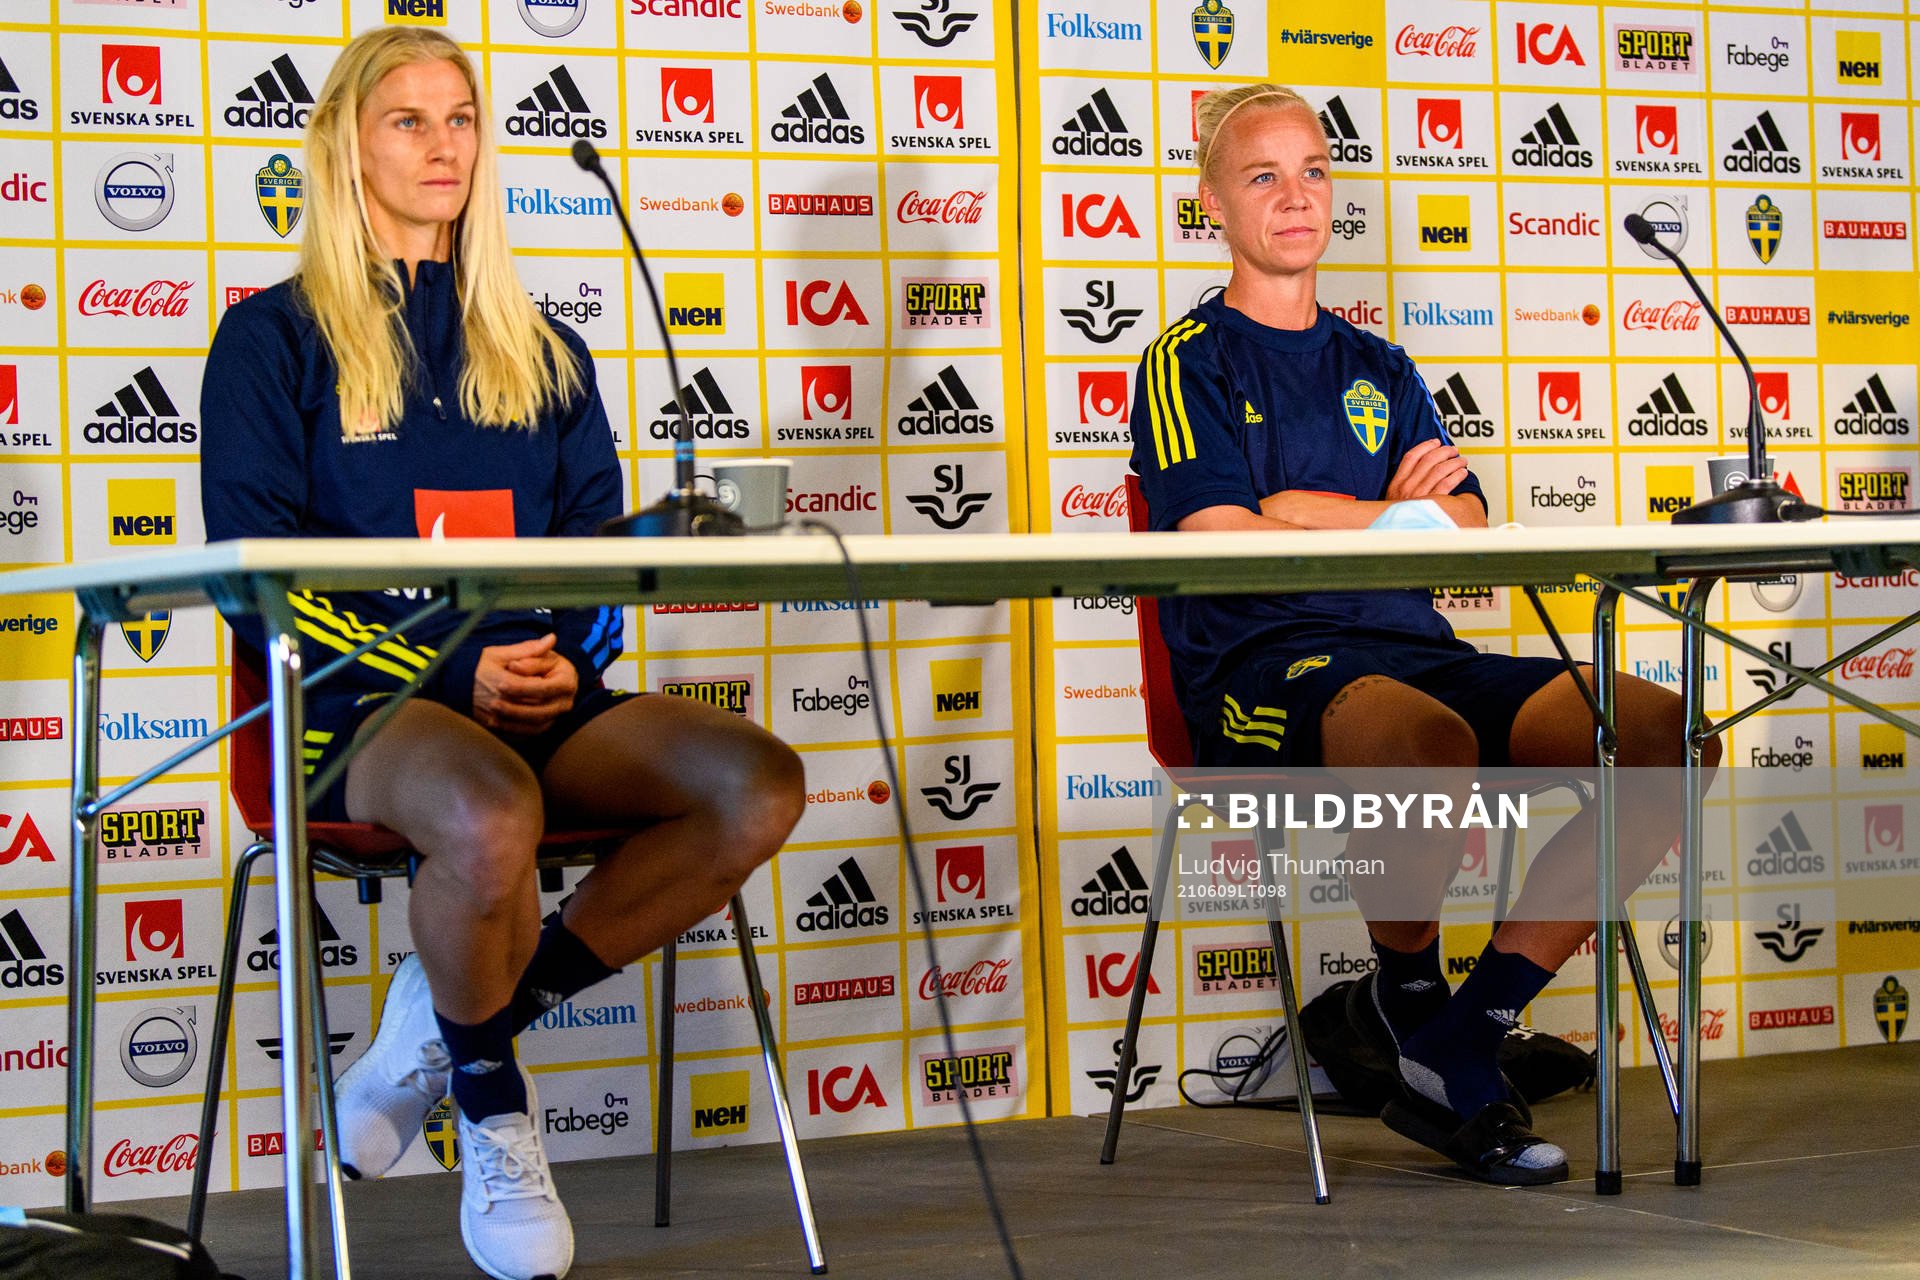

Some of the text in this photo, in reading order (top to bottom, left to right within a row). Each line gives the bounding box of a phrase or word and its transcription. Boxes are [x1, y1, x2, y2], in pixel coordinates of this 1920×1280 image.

[765, 0, 840, 18] Swedbank
[1047, 13, 1143, 41] Folksam
[1281, 28, 1373, 49] #viärsverige
[1395, 24, 1480, 58] Coca-Cola
[1516, 22, 1586, 66] ICA
[1618, 29, 1692, 61] SPORT
[1622, 61, 1691, 71] BLADET
[1727, 44, 1789, 72] Fabege
[71, 111, 195, 129] SVENSKA SPEL
[223, 101, 309, 129] adida
[505, 111, 607, 139] adidas
[636, 128, 744, 144] SVENSKA SPEL
[771, 118, 865, 146] adidas
[891, 134, 992, 150] SVENSKA SPEL
[1052, 131, 1143, 157] adidas
[1329, 139, 1373, 163] das
[1396, 154, 1489, 168] SVENSKA SPEL
[1511, 144, 1593, 168] adidas
[1616, 160, 1702, 174] SVENSKA SPEL
[1723, 151, 1801, 174] adidas
[263, 177, 298, 187] SVERIGE
[1822, 166, 1904, 179] SVENSKA SPEL
[107, 186, 163, 198] VOLVO
[506, 187, 613, 216] Folksam
[640, 196, 719, 213] Swedbank
[769, 195, 872, 215] BAUHAUS
[896, 190, 987, 225] Coca-Cola
[1062, 193, 1141, 238] ICA
[1182, 231, 1217, 240] BLA
[1332, 219, 1366, 240] ege
[1509, 212, 1600, 237] Scandic
[1825, 221, 1906, 239] BAUHAUS
[78, 279, 197, 317] Coca-Cola
[786, 280, 869, 326] ICA
[906, 283, 985, 315] SPORT
[1086, 279, 1114, 309] SJ
[529, 293, 602, 324] abege
[1326, 300, 1383, 325] ndic
[1402, 301, 1494, 327] Folksam
[1515, 309, 1580, 323] Swedbank
[1623, 300, 1702, 331] Coca-Cola
[1726, 307, 1809, 324] BAUHAUS
[1827, 311, 1910, 328] #viärsverige
[909, 316, 982, 326] BLADET
[1351, 400, 1383, 408] SVERIGE
[83, 416, 198, 443] adidas
[777, 428, 875, 441] SVENSKA SPEL
[898, 411, 994, 436] adidas
[1517, 427, 1606, 439] SVENSKA SPEL
[1628, 412, 1708, 436] adidas
[1730, 427, 1813, 438] SVEKA SPEL
[1834, 412, 1910, 435] adidas
[12, 433, 52, 447] SPEL
[1055, 431, 1119, 443] SVENSKA
[933, 465, 964, 494] SJ
[1840, 472, 1909, 500] SPORT
[1531, 485, 1596, 512] Fabege
[1844, 502, 1907, 511] BLADET
[1435, 599, 1494, 609] LADET
[793, 688, 870, 716] Fabege
[1064, 686, 1137, 700] Swedbank
[0, 718, 60, 737] HAUS
[944, 754, 971, 785] SJ
[1752, 747, 1813, 771] Fabege
[806, 787, 865, 804] edbank
[1066, 774, 1162, 801] Folksam
[102, 808, 204, 848] SPORT
[107, 845, 201, 859] BLADET
[1747, 849, 1825, 876] adidas
[1846, 858, 1920, 873] SVENSKA SPE
[1071, 890, 1151, 916] adida
[1309, 879, 1353, 904] adi
[796, 903, 889, 931] adidas
[912, 904, 1014, 924] SVENSKA SPEL
[1188, 900, 1249, 914] SVENSKA
[677, 928, 727, 944] ENSKA
[1, 960, 65, 988] das
[96, 965, 217, 985] SVENSKA SPEL
[1198, 947, 1277, 980] SPORT
[795, 977, 893, 1003] BAUHAUS
[919, 959, 1013, 1001] Coca-Cola
[1202, 978, 1279, 992] BLADET
[674, 993, 745, 1015] wedbank
[1751, 1007, 1832, 1028] BAUHAUS
[132, 1039, 187, 1055] VOLVO
[925, 1053, 1012, 1089] SPORT
[1219, 1058, 1254, 1068] VOLV
[808, 1063, 887, 1115] ICA
[931, 1085, 1011, 1102] BLADET
[545, 1109, 629, 1135] Fabege
[0, 1159, 41, 1176] bank
